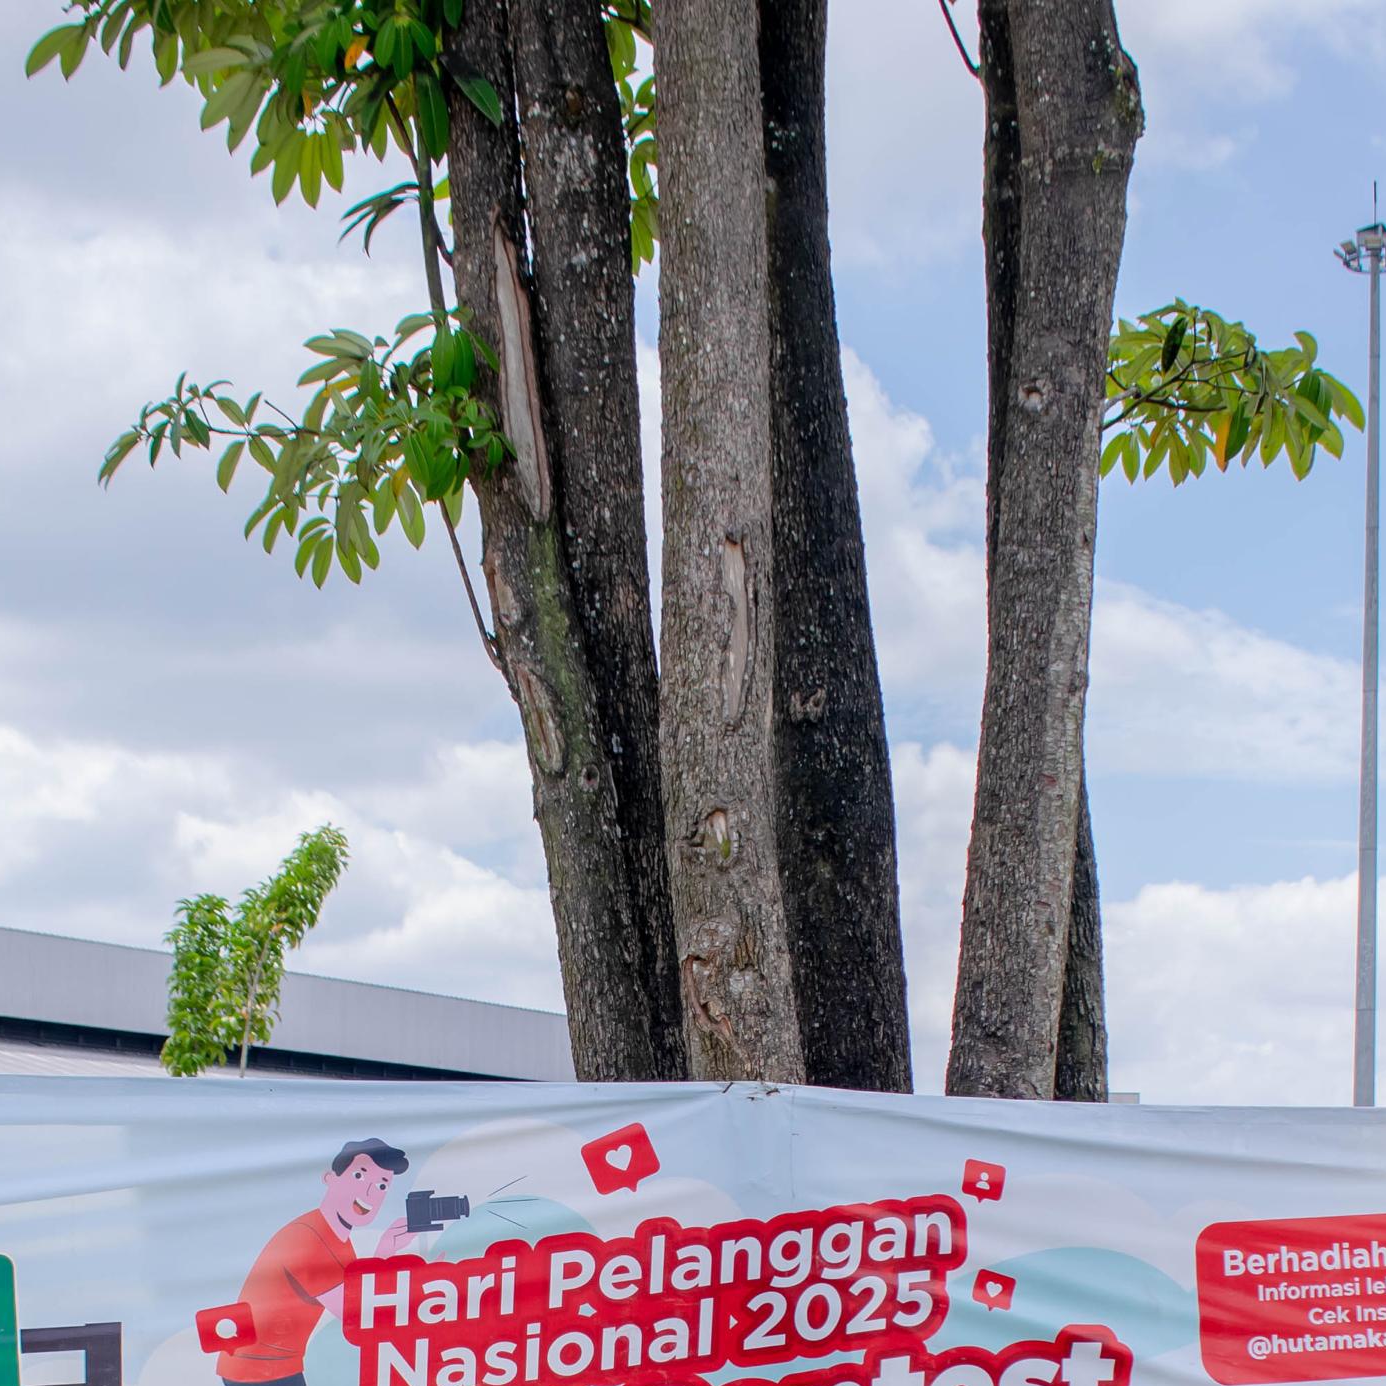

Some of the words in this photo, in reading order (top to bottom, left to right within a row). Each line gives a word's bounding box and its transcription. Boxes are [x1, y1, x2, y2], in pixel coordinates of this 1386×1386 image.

[360, 1256, 517, 1329] Hari
[548, 1210, 953, 1309] Pelanggan
[1258, 1276, 1360, 1302] Informasi
[743, 1270, 934, 1350] 2025
[1309, 1308, 1351, 1325] Cek
